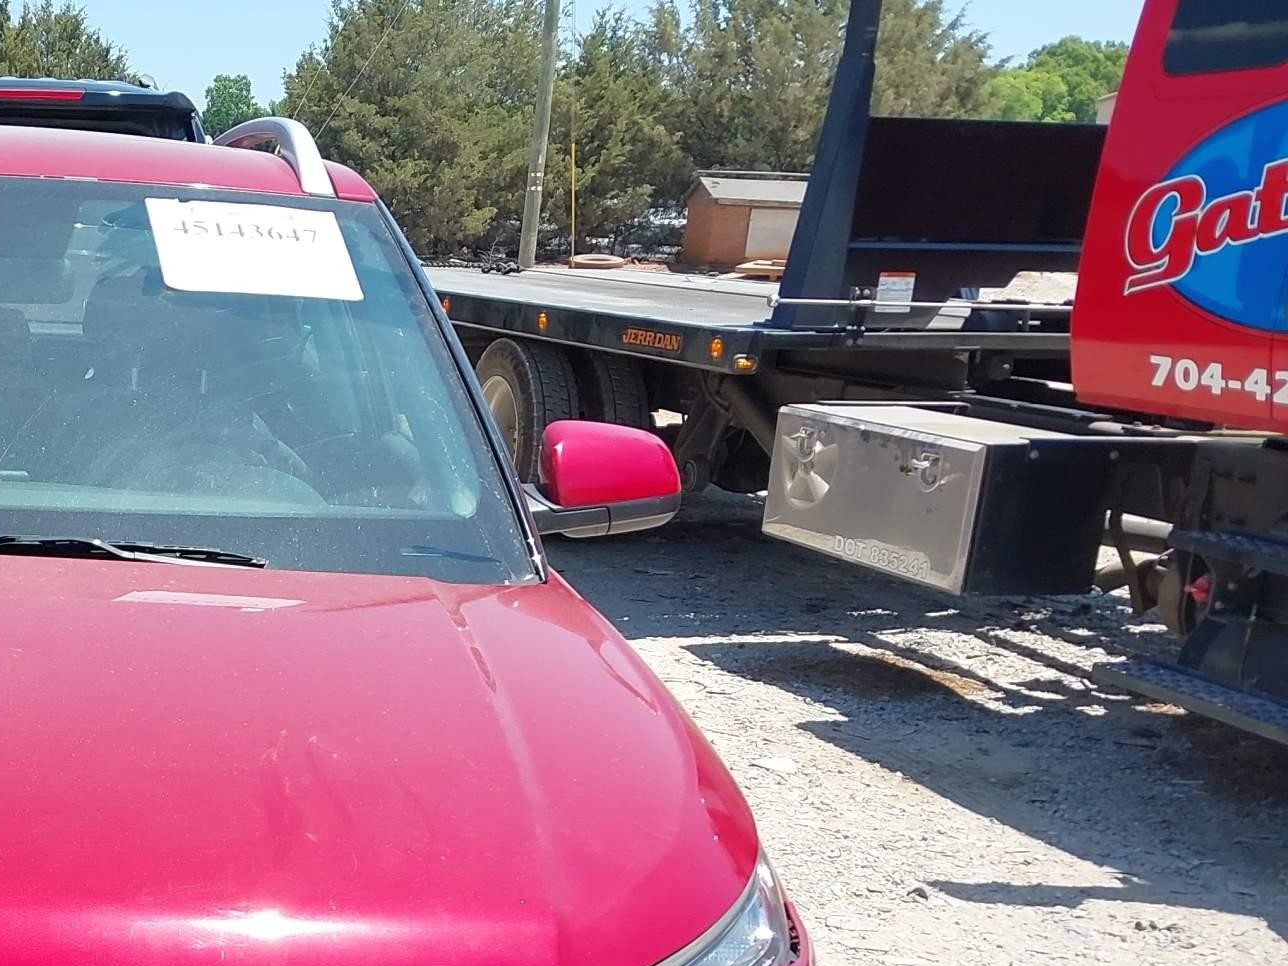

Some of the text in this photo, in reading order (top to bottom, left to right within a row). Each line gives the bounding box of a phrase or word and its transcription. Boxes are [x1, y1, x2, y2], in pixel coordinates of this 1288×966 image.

[174, 219, 317, 243] 45143647
[1150, 355, 1288, 404] 704-42
[834, 535, 929, 579] DOT 835241
